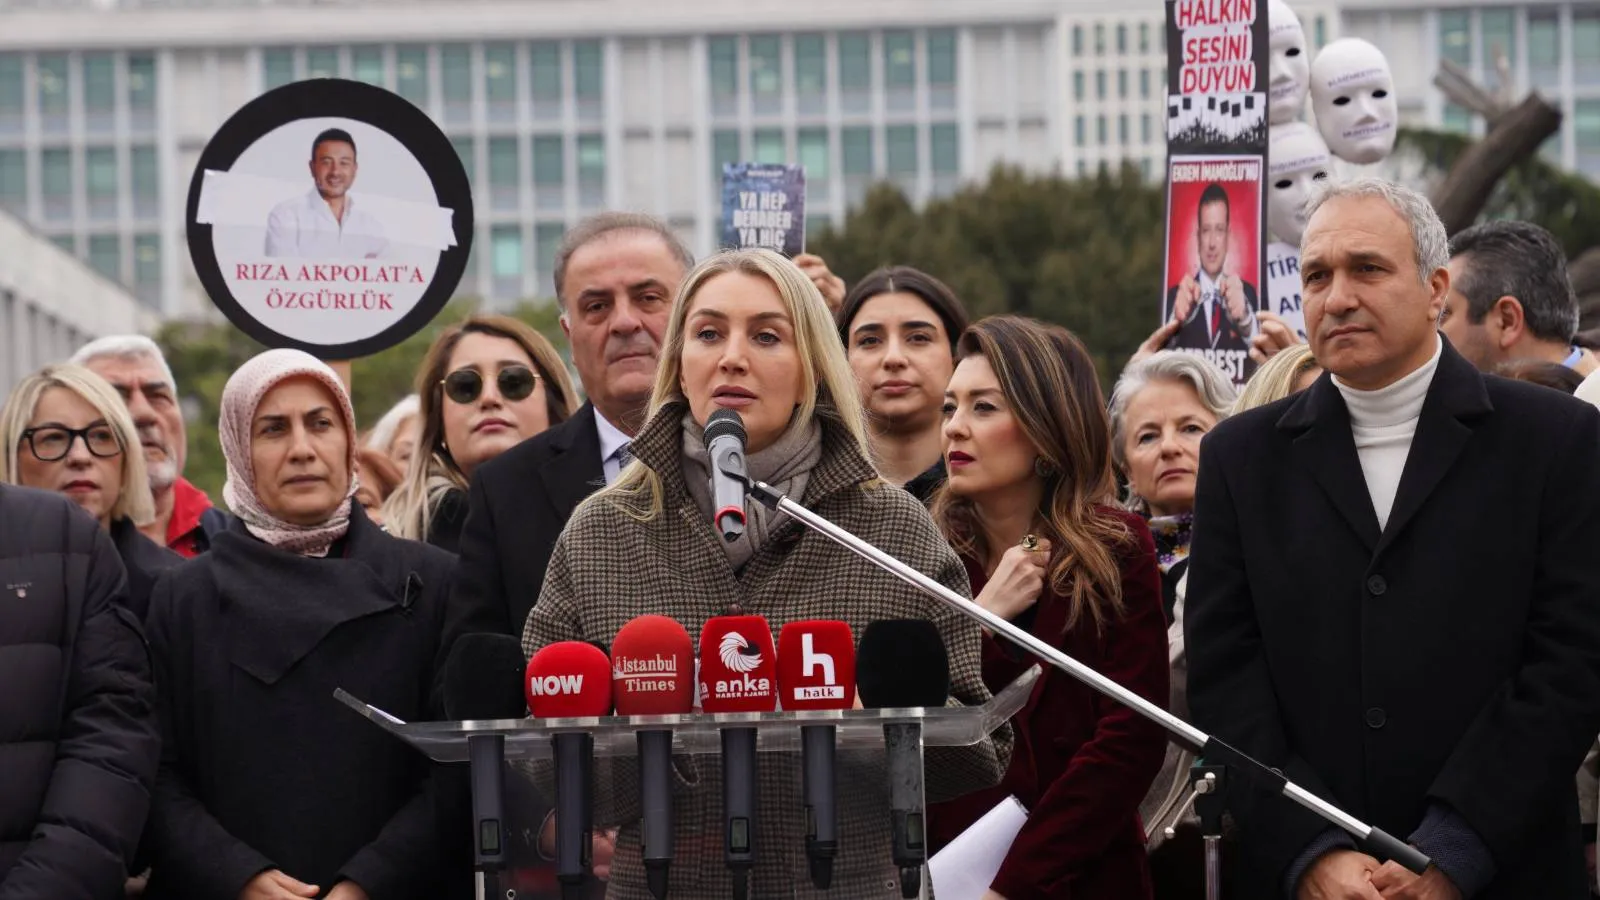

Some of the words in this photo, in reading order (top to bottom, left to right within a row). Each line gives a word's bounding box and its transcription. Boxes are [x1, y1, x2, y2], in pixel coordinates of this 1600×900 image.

[1179, 0, 1252, 26] HALKIN
[1186, 24, 1248, 65] SESİNİ
[1183, 64, 1252, 95] DUYUN
[1172, 164, 1199, 182] EKREM
[739, 191, 757, 210] YA
[739, 228, 757, 248] YA
[236, 263, 290, 281] RIZA
[297, 264, 424, 283] AKPOLAT'A
[265, 288, 395, 310] ÖZGÜRLÜK
[623, 653, 677, 672] istanbul
[531, 675, 583, 696] NOW
[625, 679, 676, 692] Times
[715, 673, 770, 693] anka
[803, 688, 835, 698] halk
